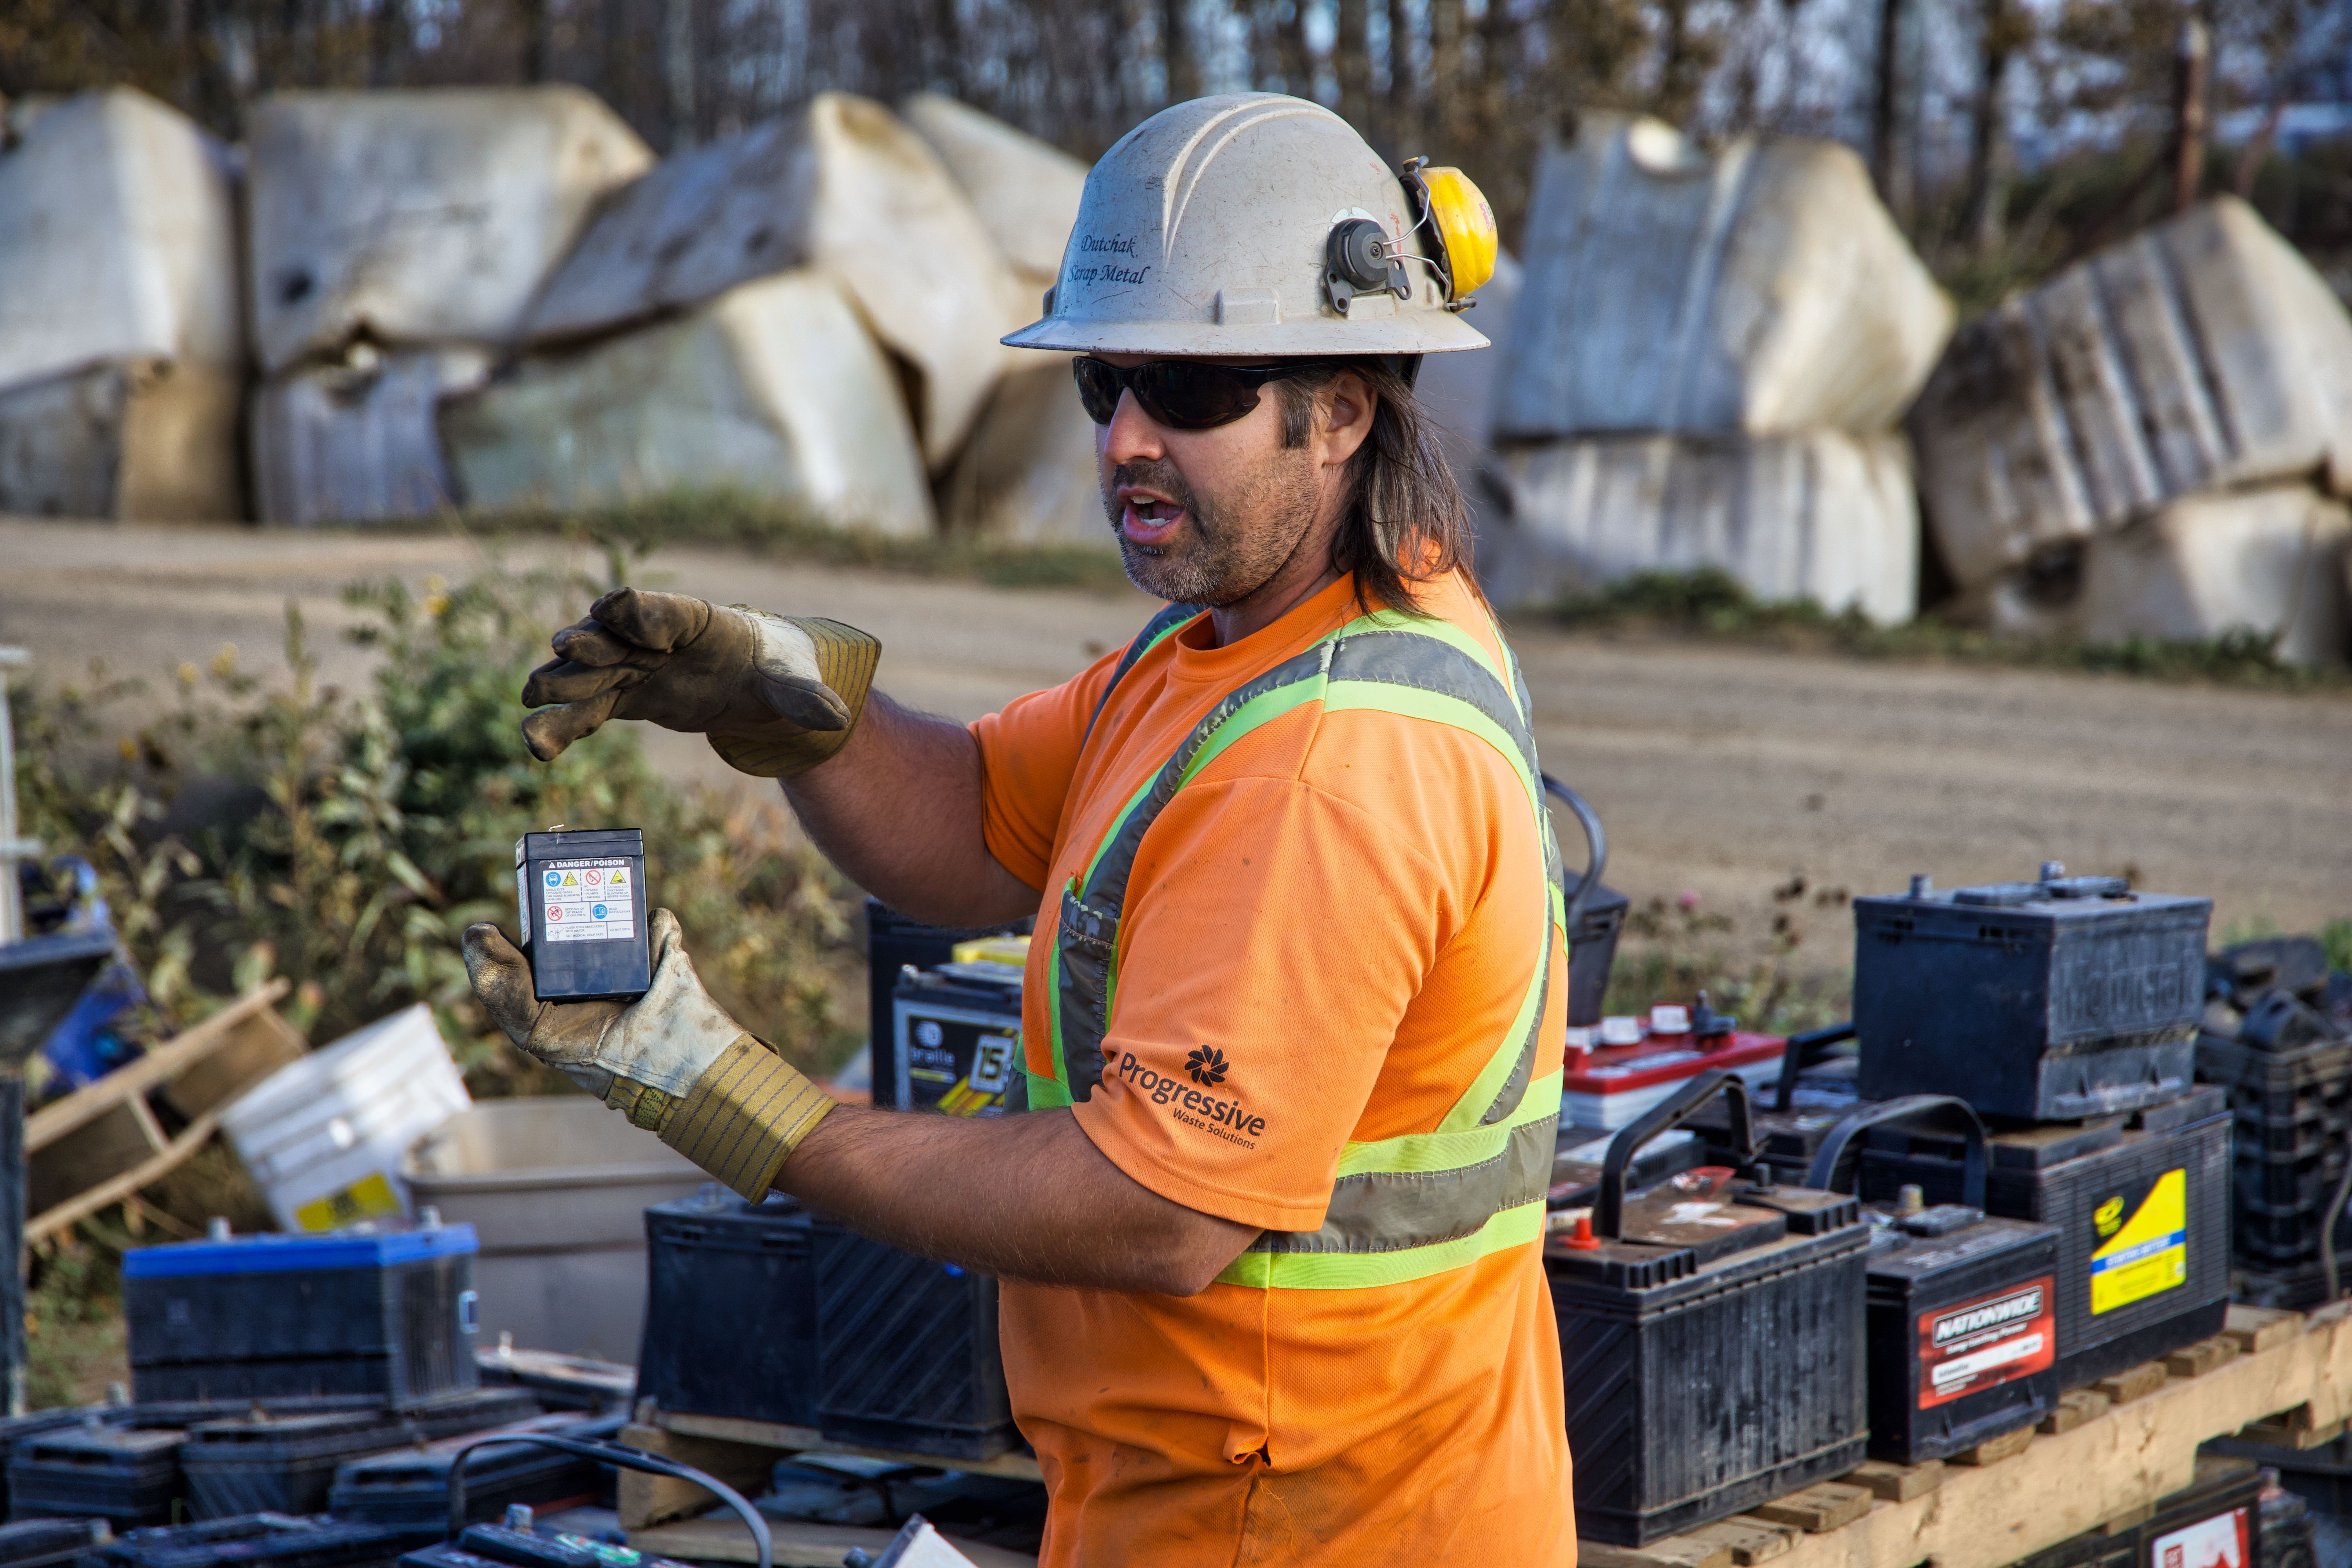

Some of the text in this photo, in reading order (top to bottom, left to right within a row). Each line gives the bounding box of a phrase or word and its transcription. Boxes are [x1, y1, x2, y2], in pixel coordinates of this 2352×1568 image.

[1081, 234, 1138, 258] Dutchak
[1068, 265, 1151, 286] Scrap Metal
[557, 859, 624, 868] DANGER/POISON
[1119, 1052, 1265, 1136] Progressive
[1173, 1107, 1255, 1150] Waste Solutions
[1936, 1292, 2041, 1341] NATIONWIDE
